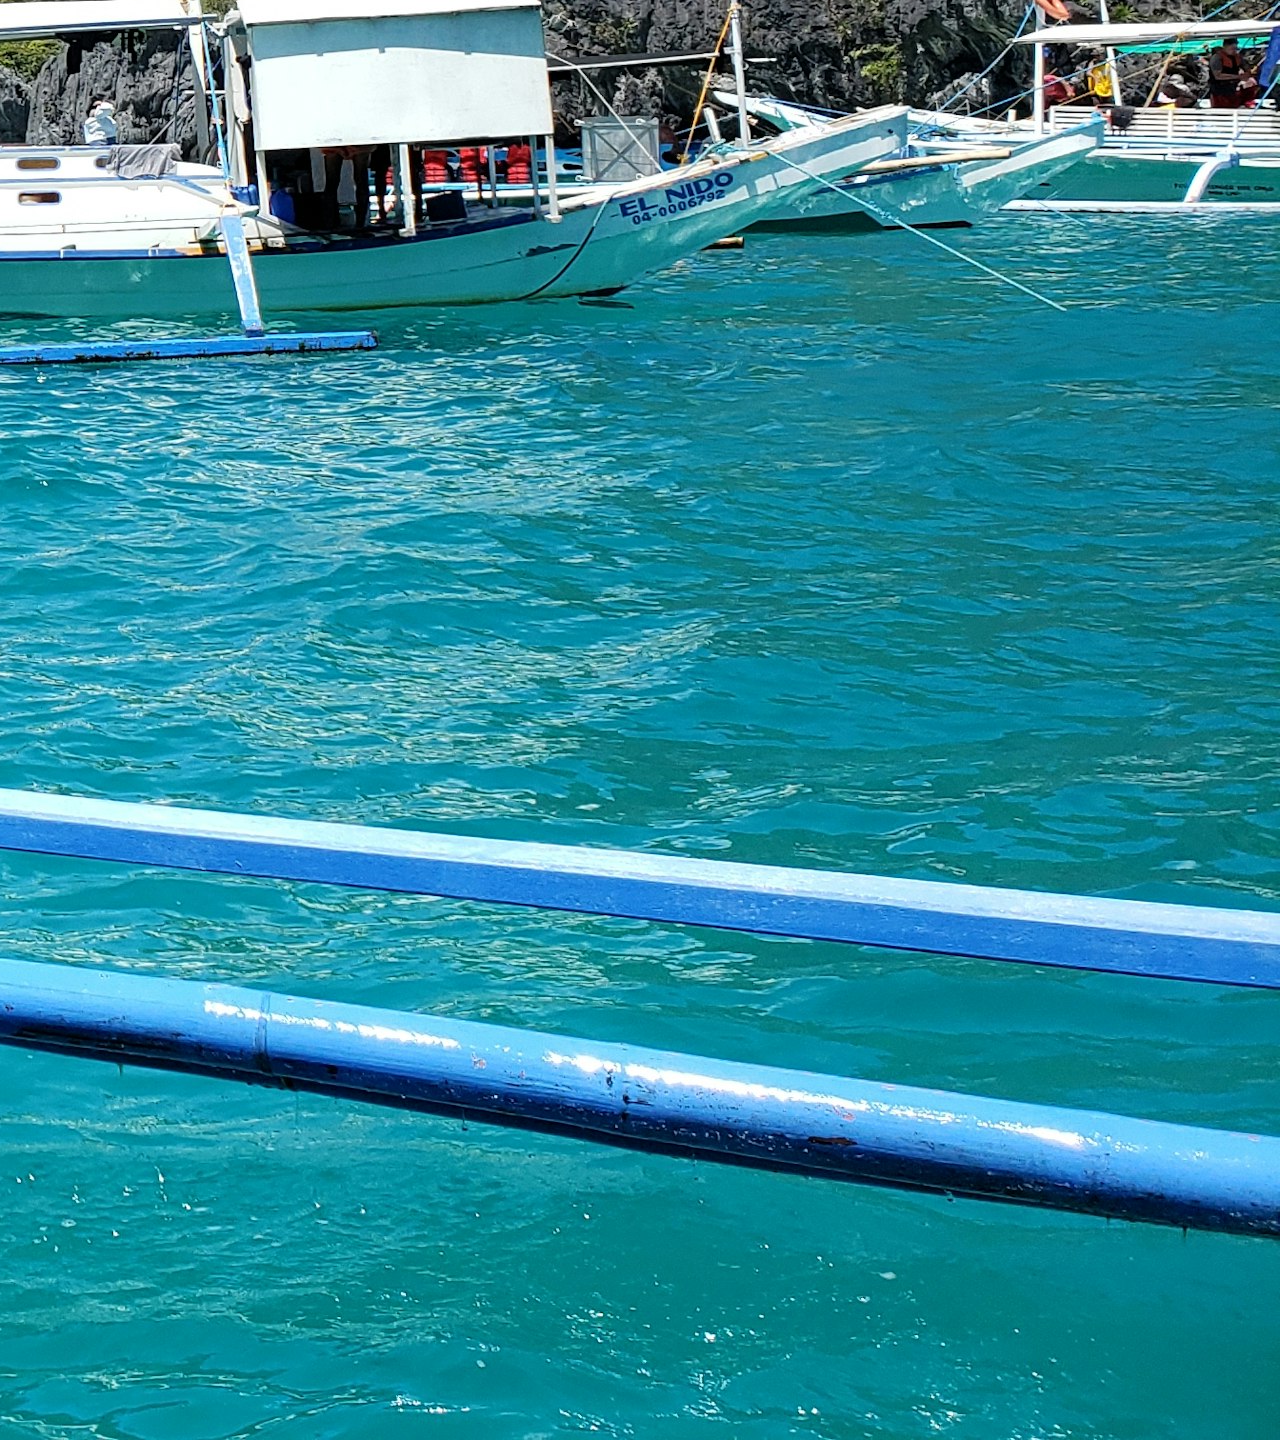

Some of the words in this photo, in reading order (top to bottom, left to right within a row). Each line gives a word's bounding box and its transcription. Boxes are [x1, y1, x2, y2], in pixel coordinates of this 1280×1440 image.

[619, 197, 658, 217] EL
[665, 172, 734, 203] NIDO
[632, 189, 725, 225] 04-0006792
